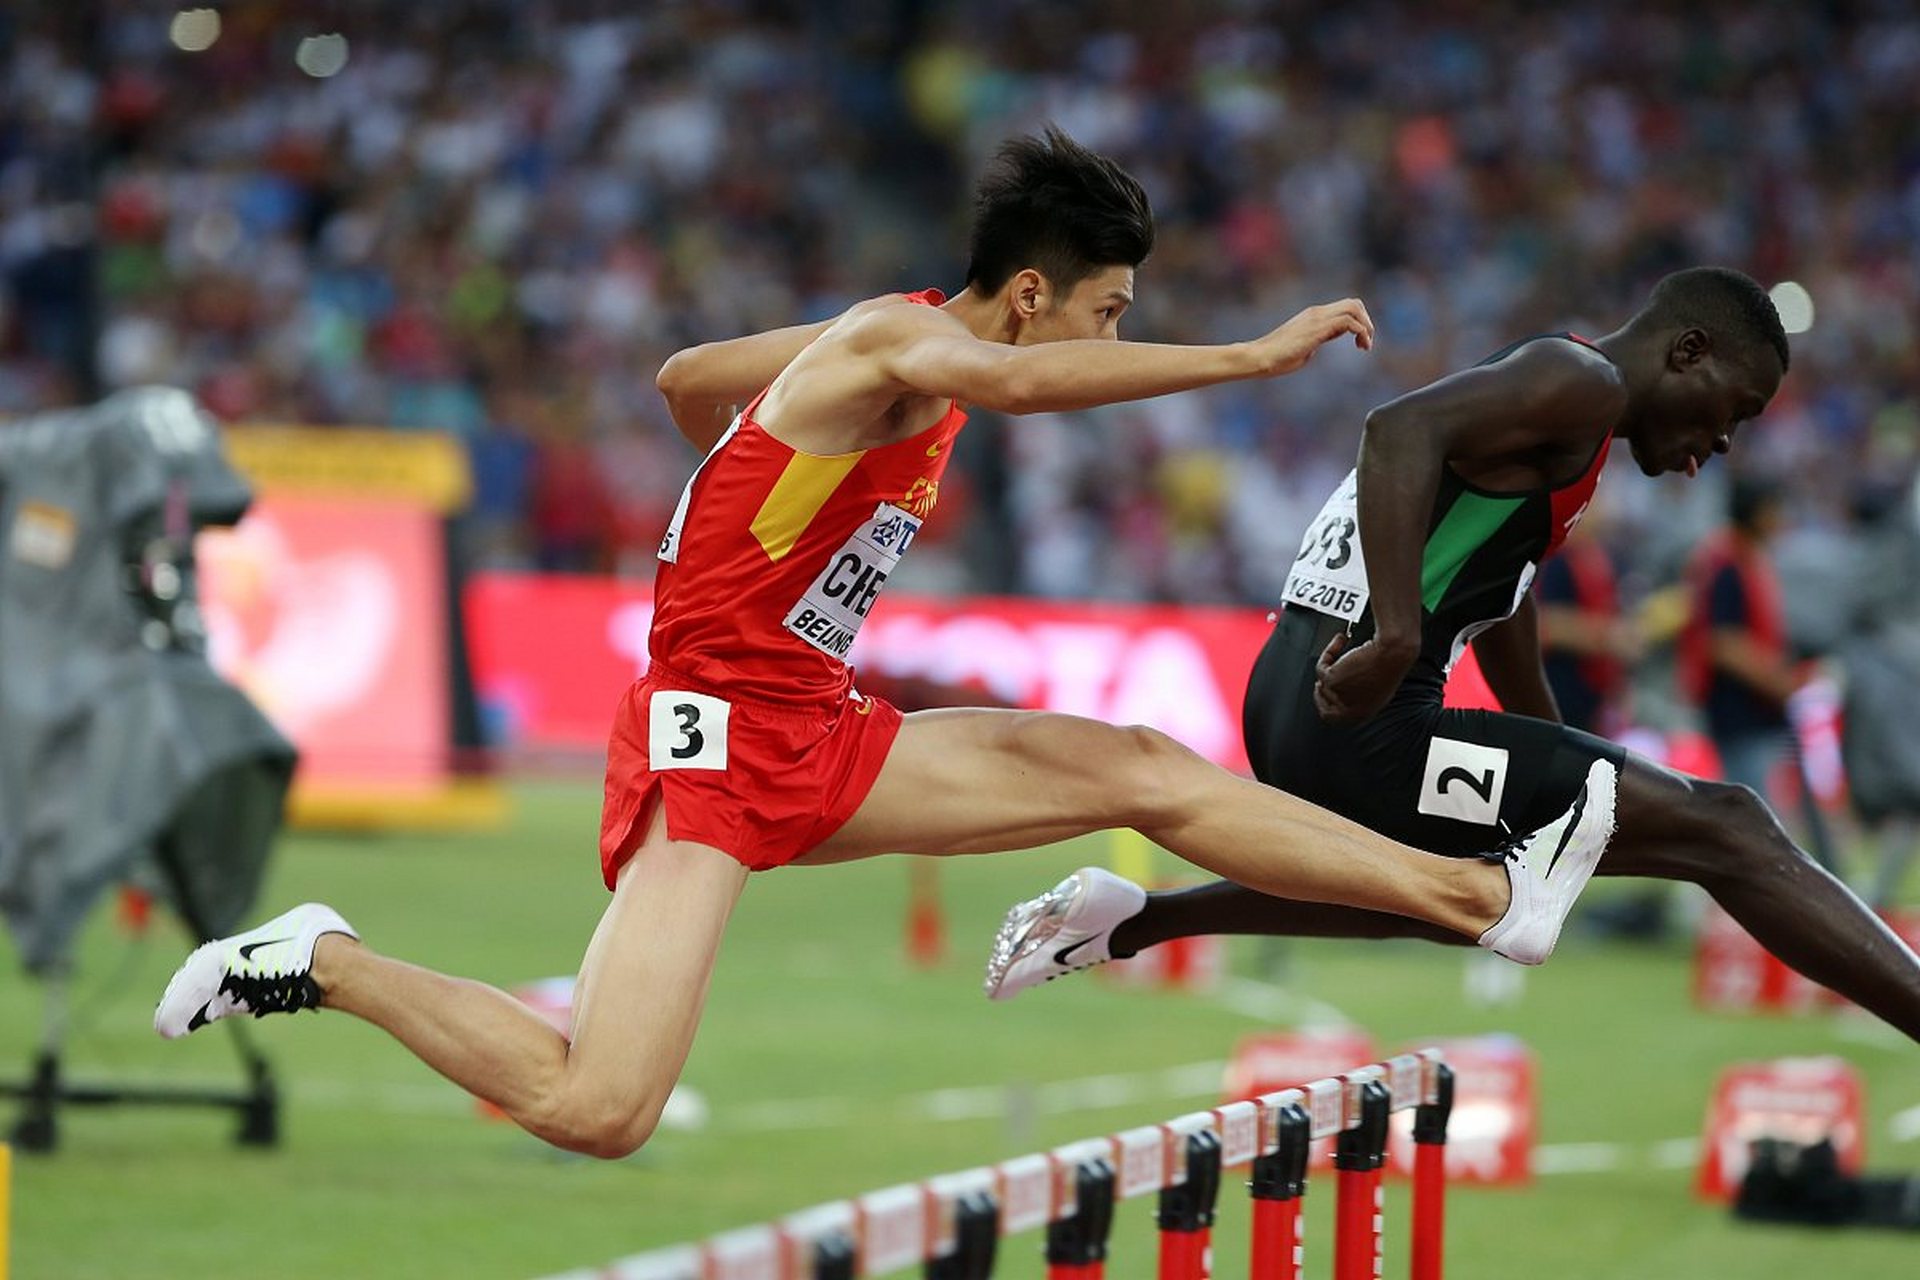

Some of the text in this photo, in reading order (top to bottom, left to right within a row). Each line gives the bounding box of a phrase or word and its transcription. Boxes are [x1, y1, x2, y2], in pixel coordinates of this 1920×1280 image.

[822, 553, 887, 618] CHE
[1309, 585, 1360, 614] 2015
[671, 704, 704, 758] 3
[1437, 766, 1495, 803] 2
